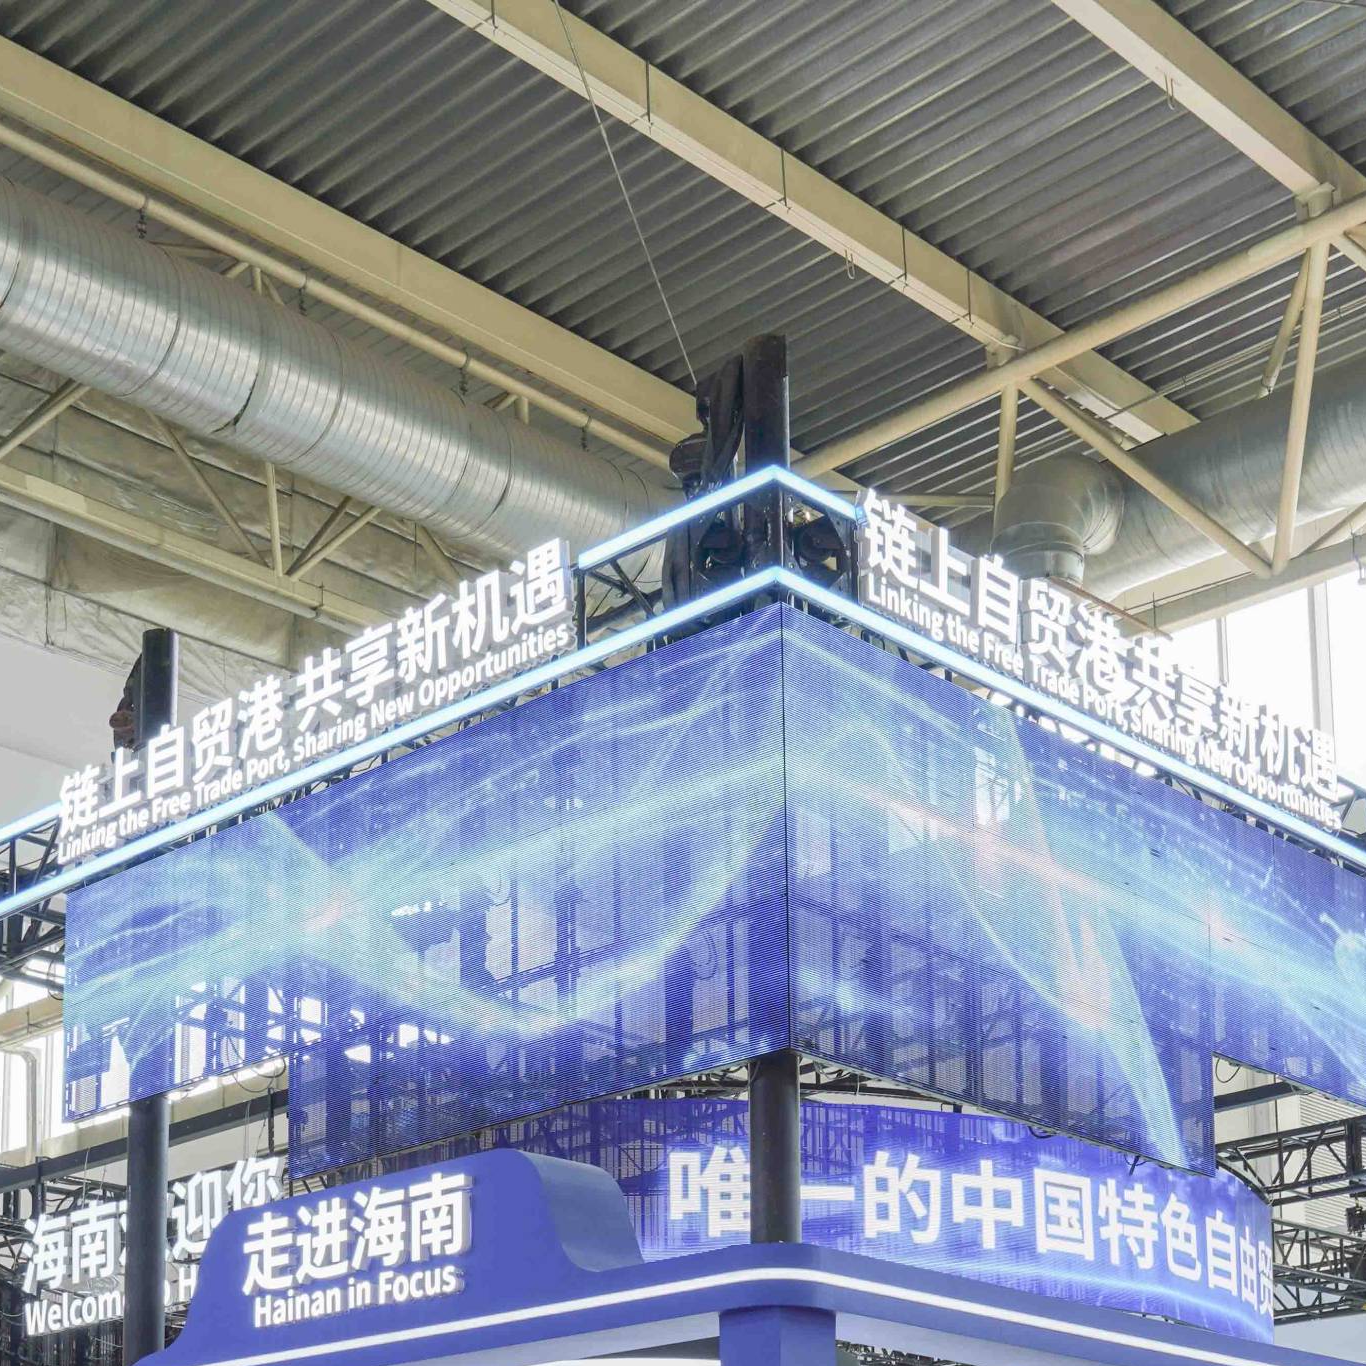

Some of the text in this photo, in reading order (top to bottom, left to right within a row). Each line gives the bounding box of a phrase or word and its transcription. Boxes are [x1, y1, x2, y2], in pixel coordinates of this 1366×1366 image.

[294, 537, 569, 732] 共享新机遇
[867, 572, 944, 642] Linking
[947, 614, 980, 654] the
[984, 631, 1025, 676] Free
[1030, 655, 1080, 705] Trade
[57, 623, 570, 865] Linking the Free Trade Port, Sharing New Opportunities
[22, 1157, 283, 1294] 海南迎你
[242, 1172, 467, 1296] 走进海南
[25, 1290, 125, 1336] Welcom
[254, 1265, 458, 1328] Hainan in Focus
